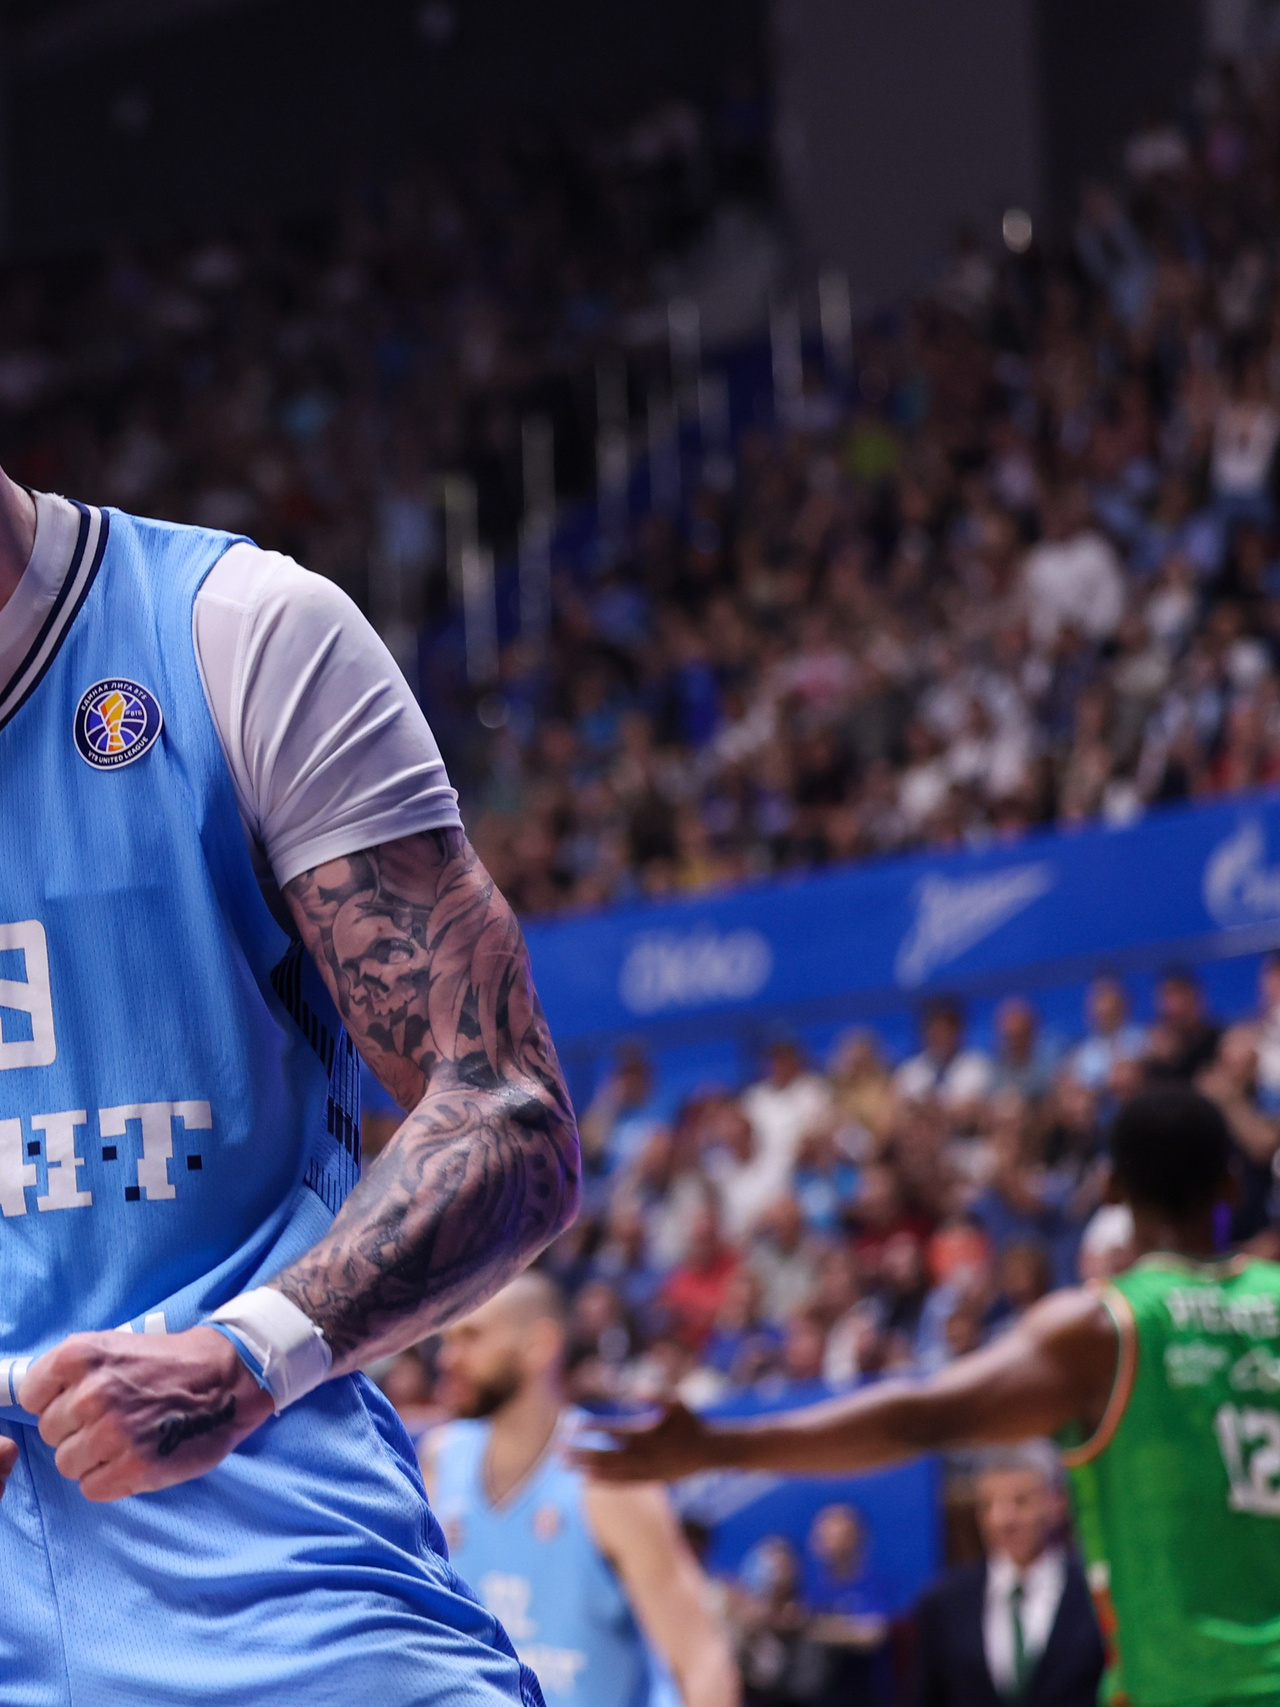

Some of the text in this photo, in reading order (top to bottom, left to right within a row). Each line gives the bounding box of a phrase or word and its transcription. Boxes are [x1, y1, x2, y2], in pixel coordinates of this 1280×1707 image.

[111, 682, 133, 692] ЛИГА
[99, 755, 124, 764] UNITED
[124, 736, 149, 759] LEAGUE
